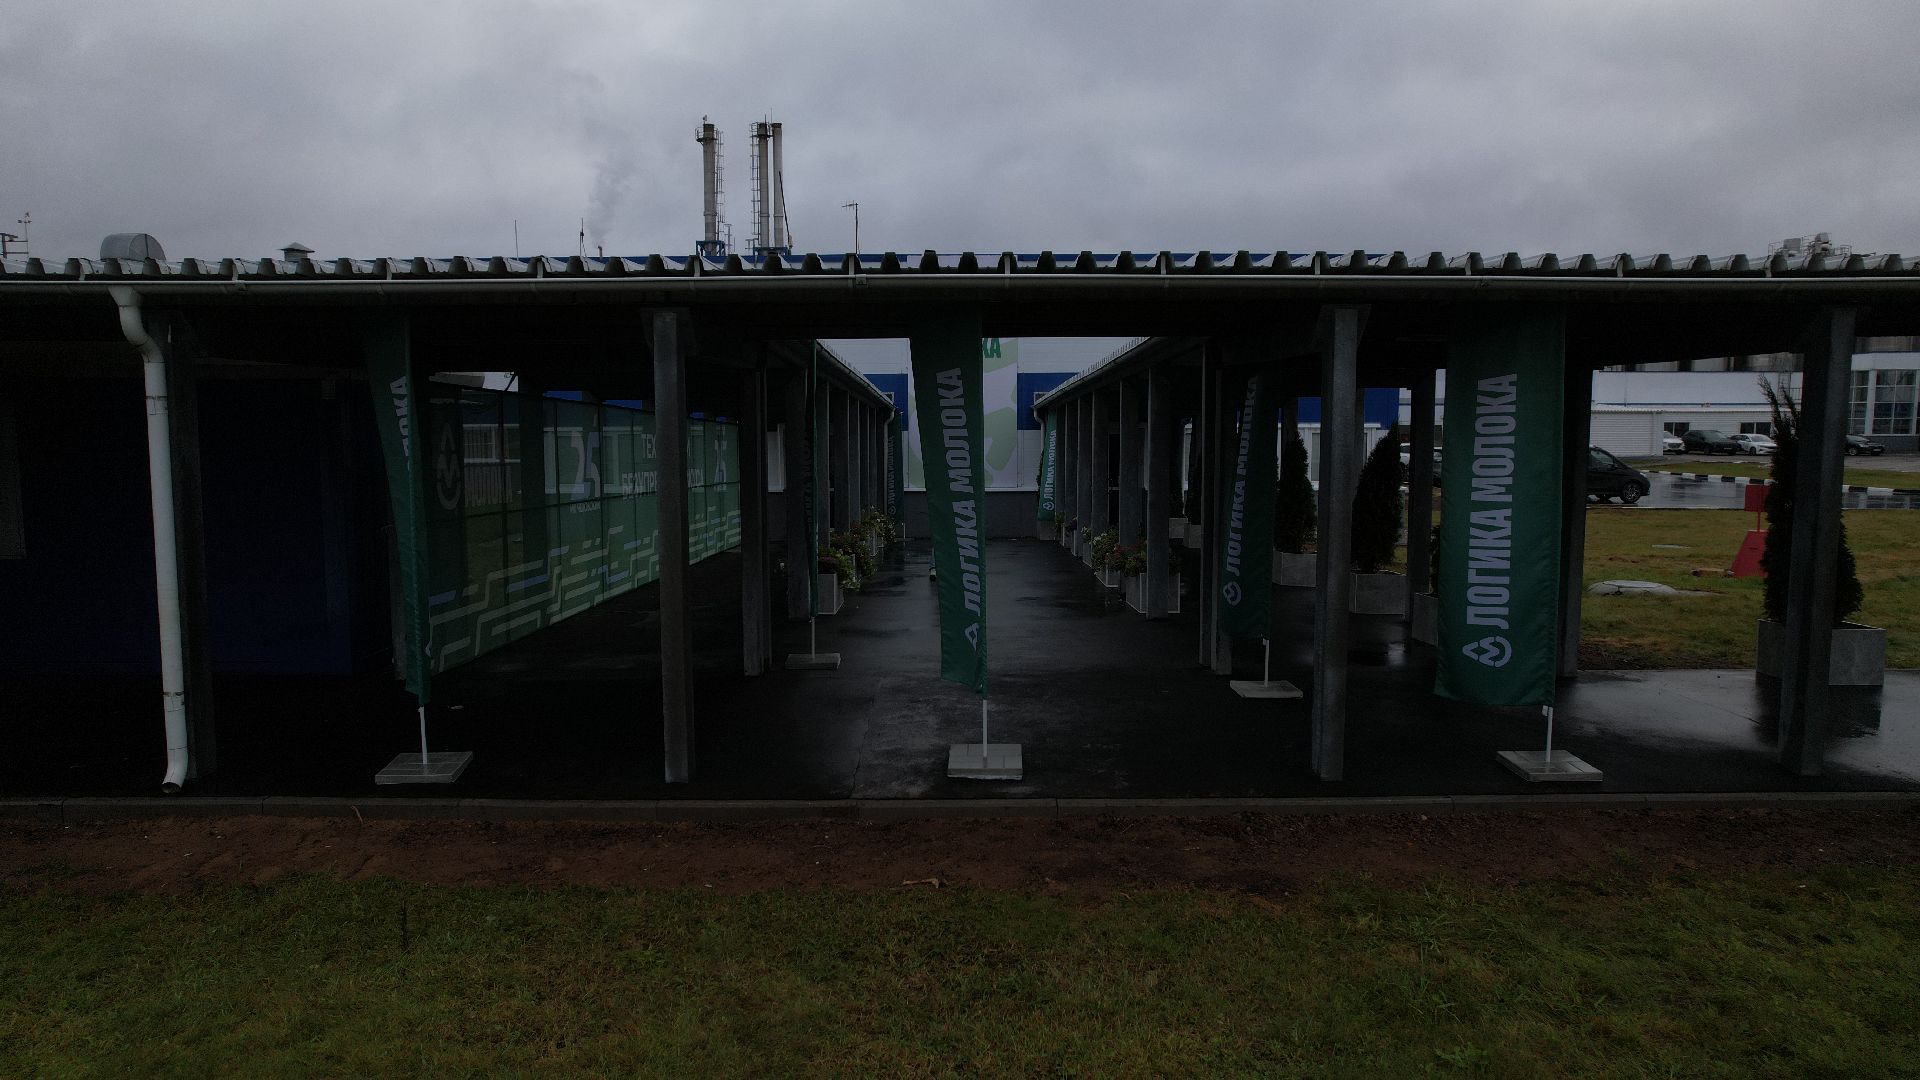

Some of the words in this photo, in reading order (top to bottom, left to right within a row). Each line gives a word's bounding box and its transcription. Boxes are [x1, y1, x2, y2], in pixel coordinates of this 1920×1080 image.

[936, 367, 974, 493] МОЛОКА
[1043, 466, 1055, 500] ЛОГИКА
[1470, 373, 1517, 502] МОЛОКА
[952, 500, 980, 616] ЛОГИКА
[1224, 480, 1246, 576] ЛОГИКА
[1466, 508, 1512, 629] ЛОГИКА
